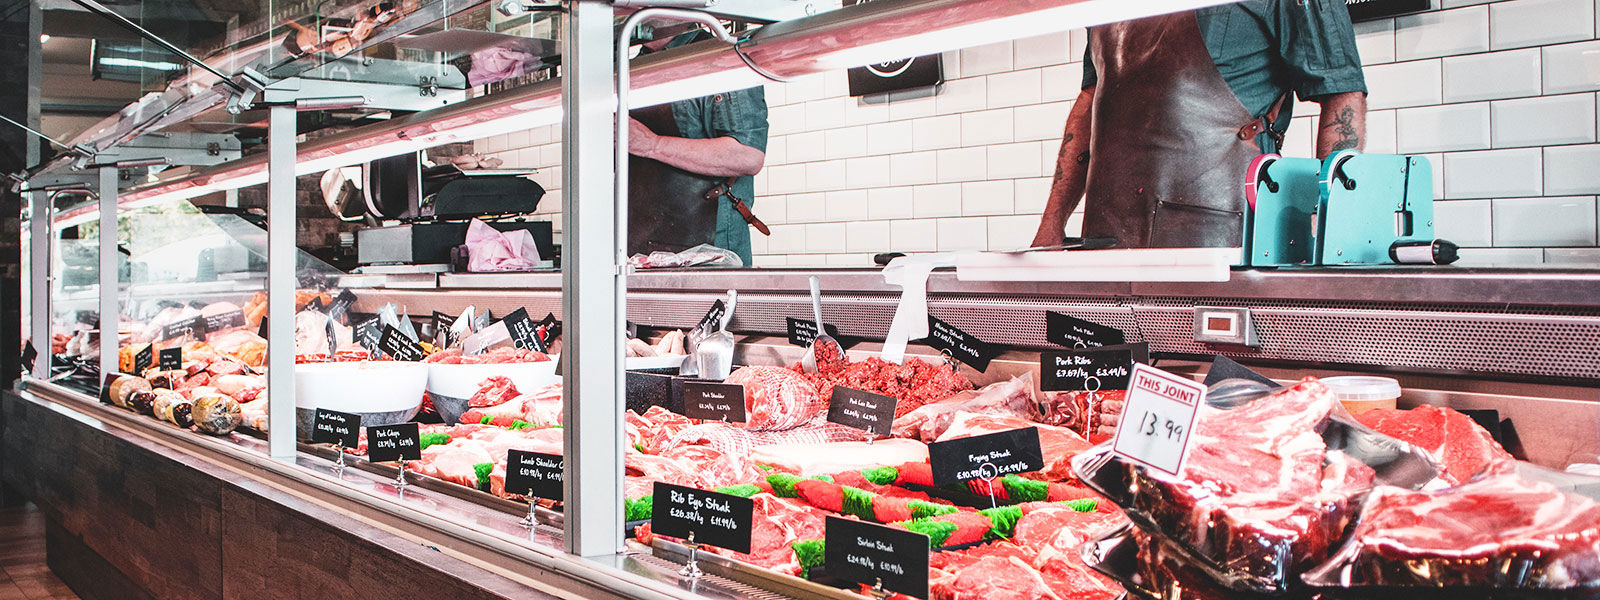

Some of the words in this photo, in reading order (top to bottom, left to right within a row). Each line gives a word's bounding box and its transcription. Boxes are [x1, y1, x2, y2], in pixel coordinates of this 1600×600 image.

[1056, 356, 1073, 366] Pork
[1074, 356, 1092, 365] Ribs
[1056, 367, 1088, 378] £7.67/kg
[1096, 366, 1127, 377] £3.49/lb
[1138, 375, 1160, 391] THIS
[1162, 385, 1195, 403] JOINT
[1139, 410, 1183, 442] 13.99
[376, 429, 387, 438] Pork
[386, 429, 400, 439] Chops
[990, 449, 1011, 459] Steak
[520, 455, 535, 465] Lamb
[536, 457, 558, 468] Shoulder
[998, 461, 1029, 474] £4.99/lb
[670, 490, 685, 504] Rib
[688, 493, 703, 510] Eye
[705, 497, 731, 513] Steak
[710, 515, 737, 530] £11.99/lb
[876, 540, 894, 552] Steak
